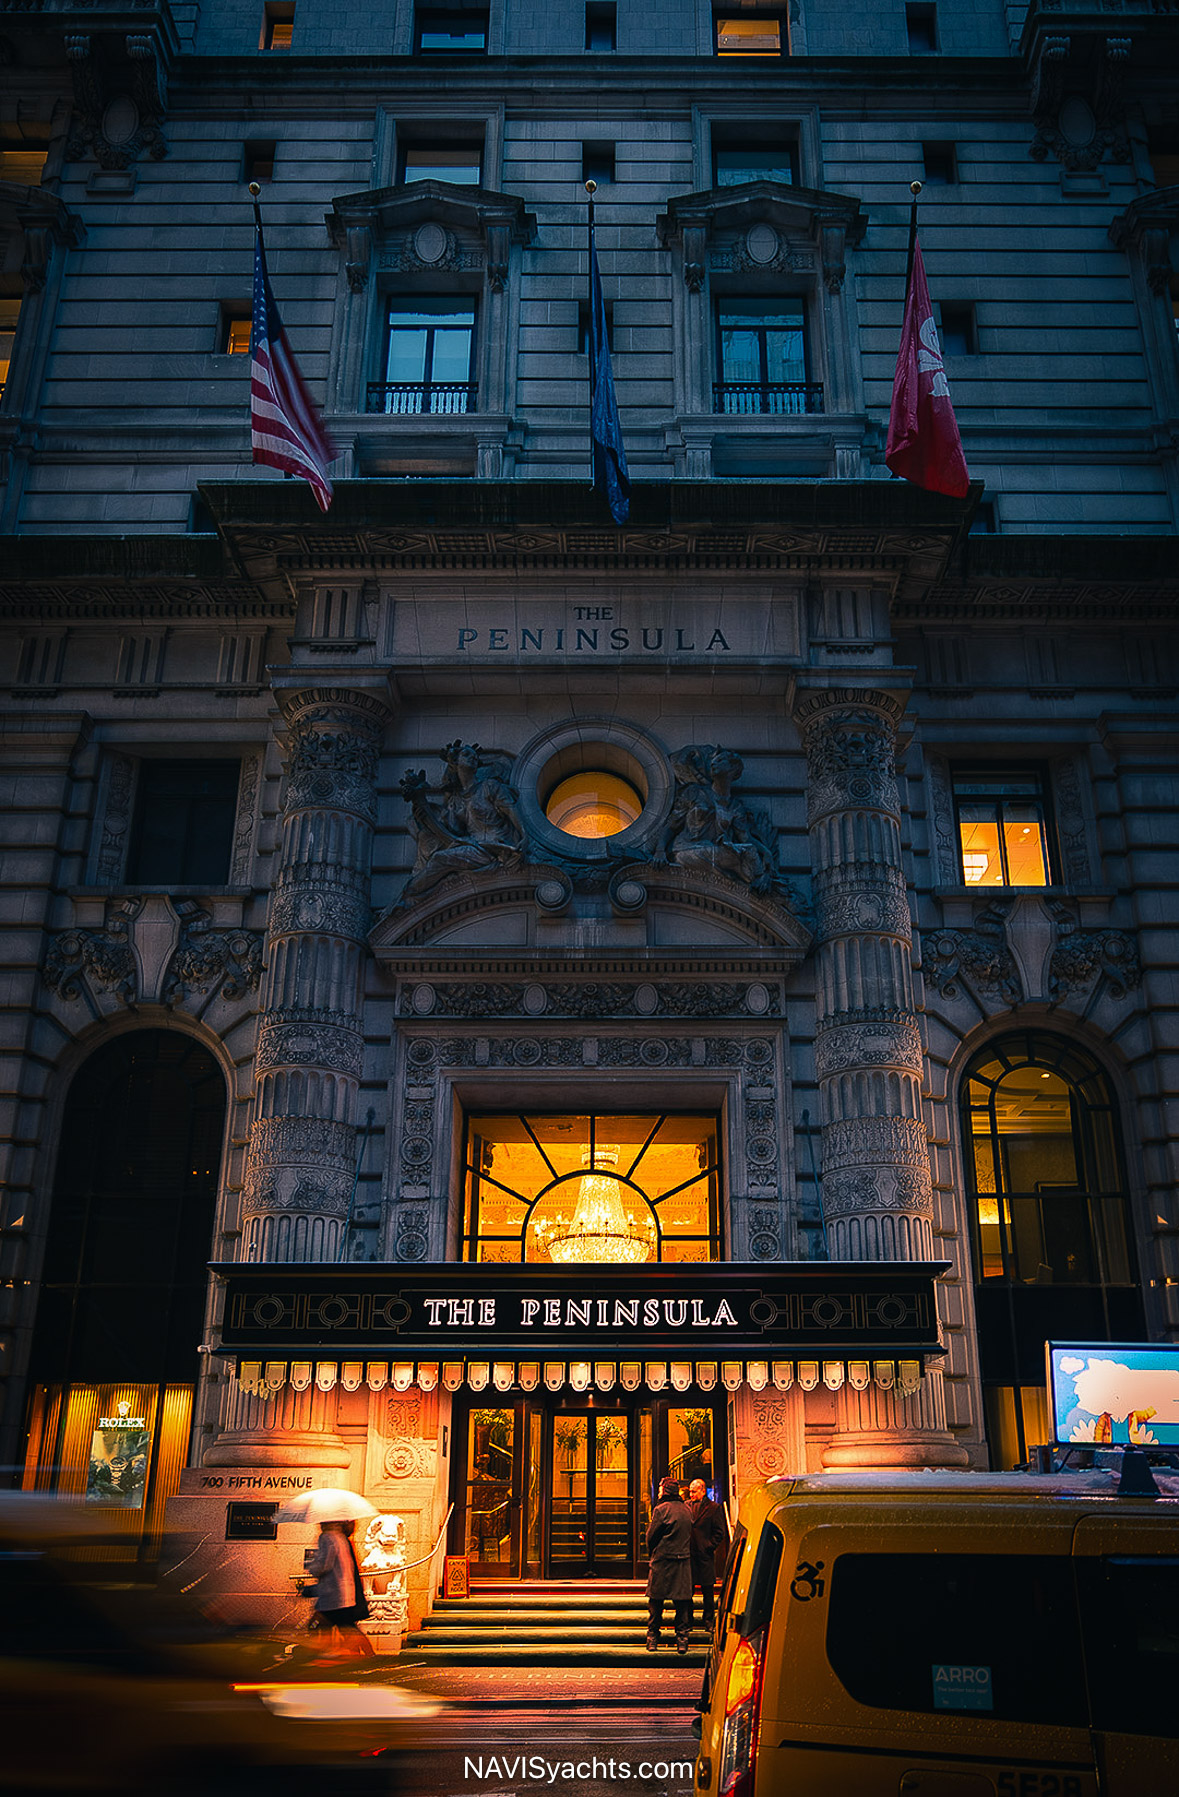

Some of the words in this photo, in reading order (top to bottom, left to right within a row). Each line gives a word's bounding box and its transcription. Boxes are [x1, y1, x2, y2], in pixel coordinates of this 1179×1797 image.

[573, 606, 614, 621] THE
[456, 627, 732, 651] PENINSULA
[423, 1298, 497, 1327] THE
[520, 1298, 738, 1327] PENINSULA
[98, 1417, 146, 1428] ROLEX
[201, 1476, 224, 1488] 700
[227, 1476, 262, 1488] FIFTH
[264, 1476, 313, 1488] AVENUE
[935, 1667, 989, 1684] ARRO
